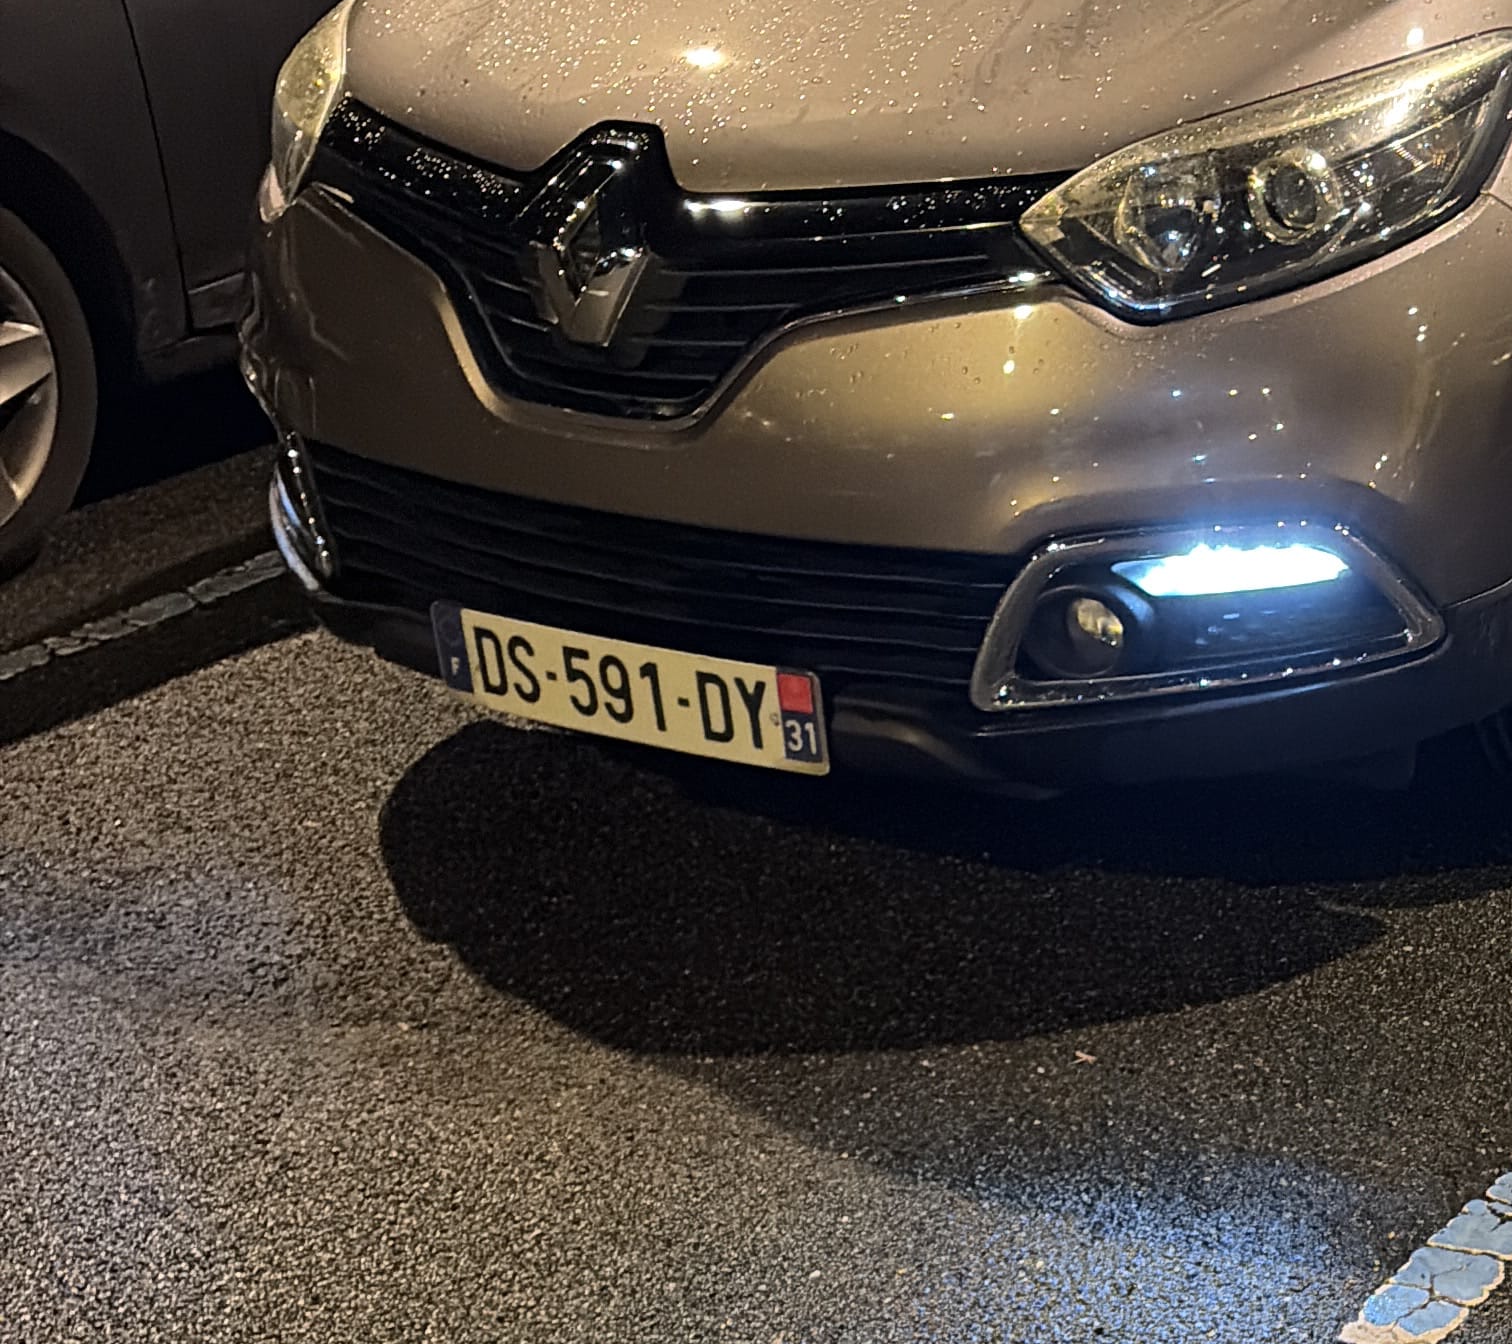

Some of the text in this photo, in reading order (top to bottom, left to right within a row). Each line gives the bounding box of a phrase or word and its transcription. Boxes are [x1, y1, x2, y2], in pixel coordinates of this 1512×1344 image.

[450, 657, 460, 676] F
[473, 626, 766, 750] DS-591-DY
[785, 719, 817, 755] 31
